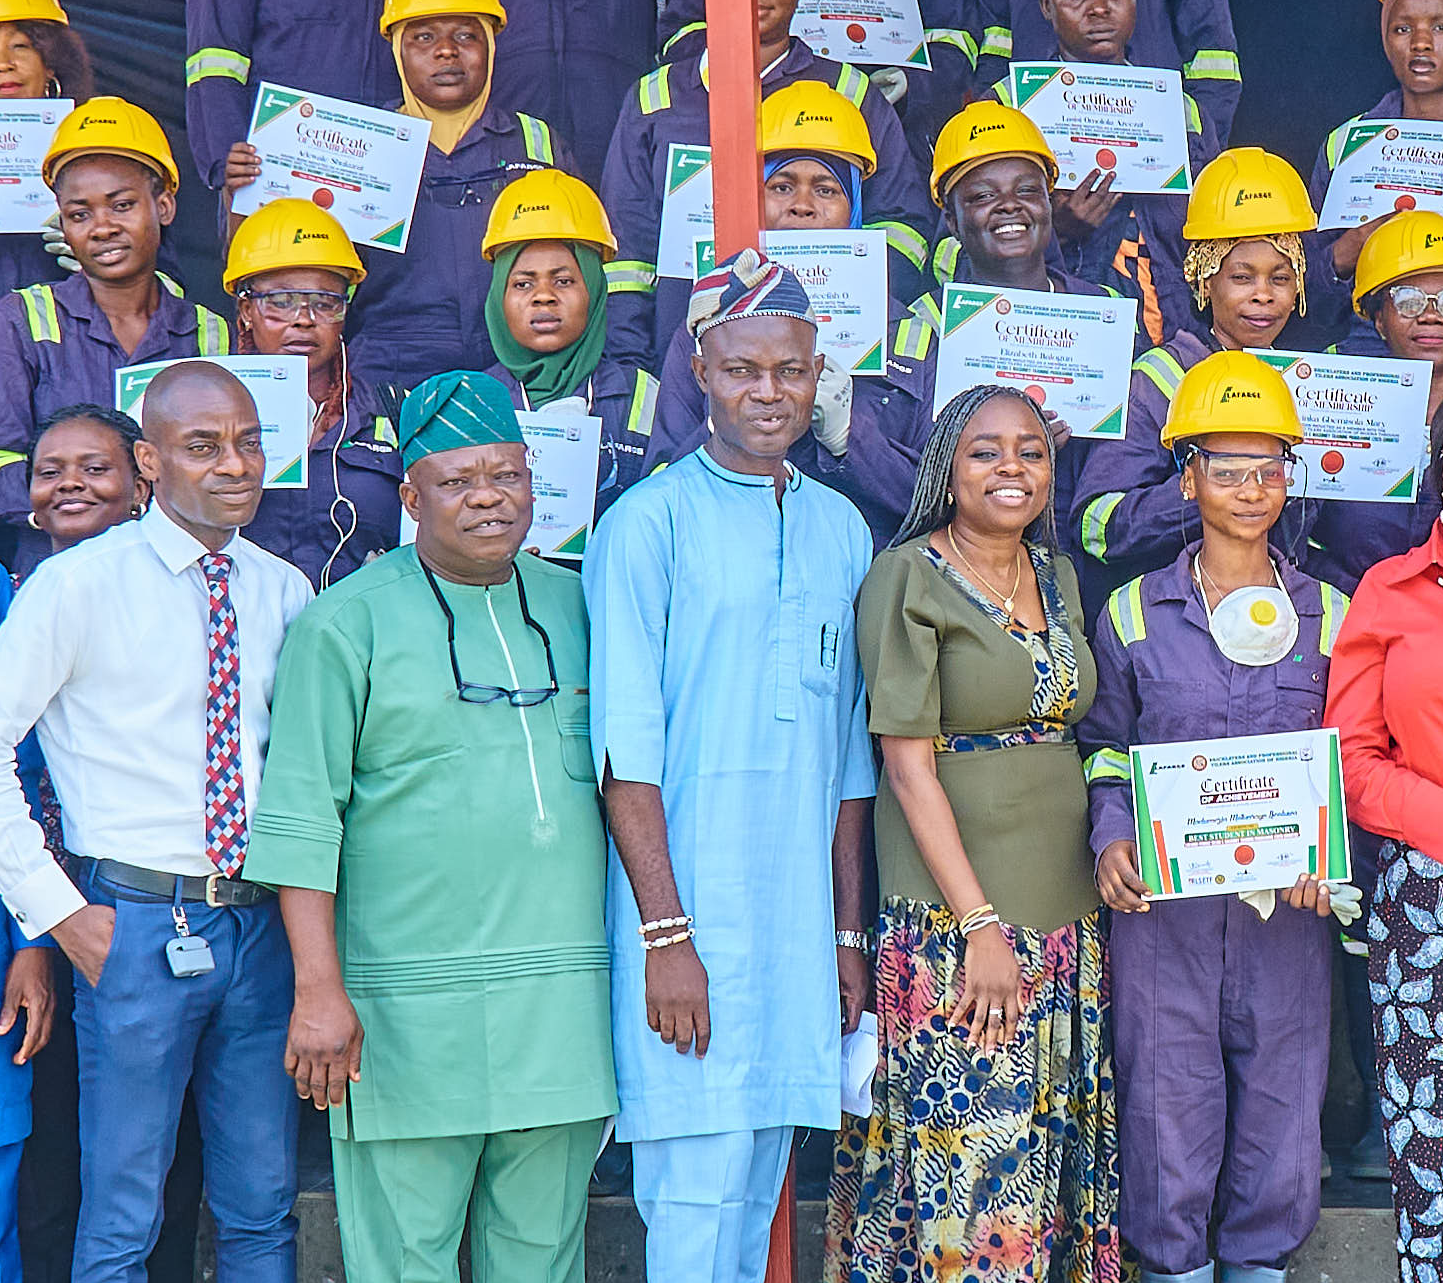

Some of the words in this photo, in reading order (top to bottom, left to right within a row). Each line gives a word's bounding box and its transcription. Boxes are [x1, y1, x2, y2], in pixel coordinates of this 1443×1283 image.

[1064, 91, 1137, 107] Certificate
[1082, 104, 1134, 114] MEMBERSHIP
[78, 116, 117, 131] LAFARGE
[794, 110, 833, 127] LAFARGE
[295, 122, 373, 151] Certificate
[969, 124, 1006, 142] LAFARGE
[1234, 189, 1272, 207] LAFARGE
[512, 203, 550, 221] LAFARGE
[292, 228, 329, 245] LAFARGE
[995, 321, 1079, 340] Certificate
[1014, 335, 1074, 348] MEMBERSHIP
[1219, 386, 1261, 404] LAFARGE
[1295, 386, 1378, 404] Certificate
[1314, 400, 1373, 412] MEMBERSHIP
[1200, 776, 1275, 794] Certificate
[1201, 796, 1214, 804] OF
[1216, 790, 1278, 803] ACHIEVEMENT
[1188, 834, 1208, 842] BEST
[1210, 830, 1245, 841] STUDENT
[1257, 826, 1296, 836] MASONRY
